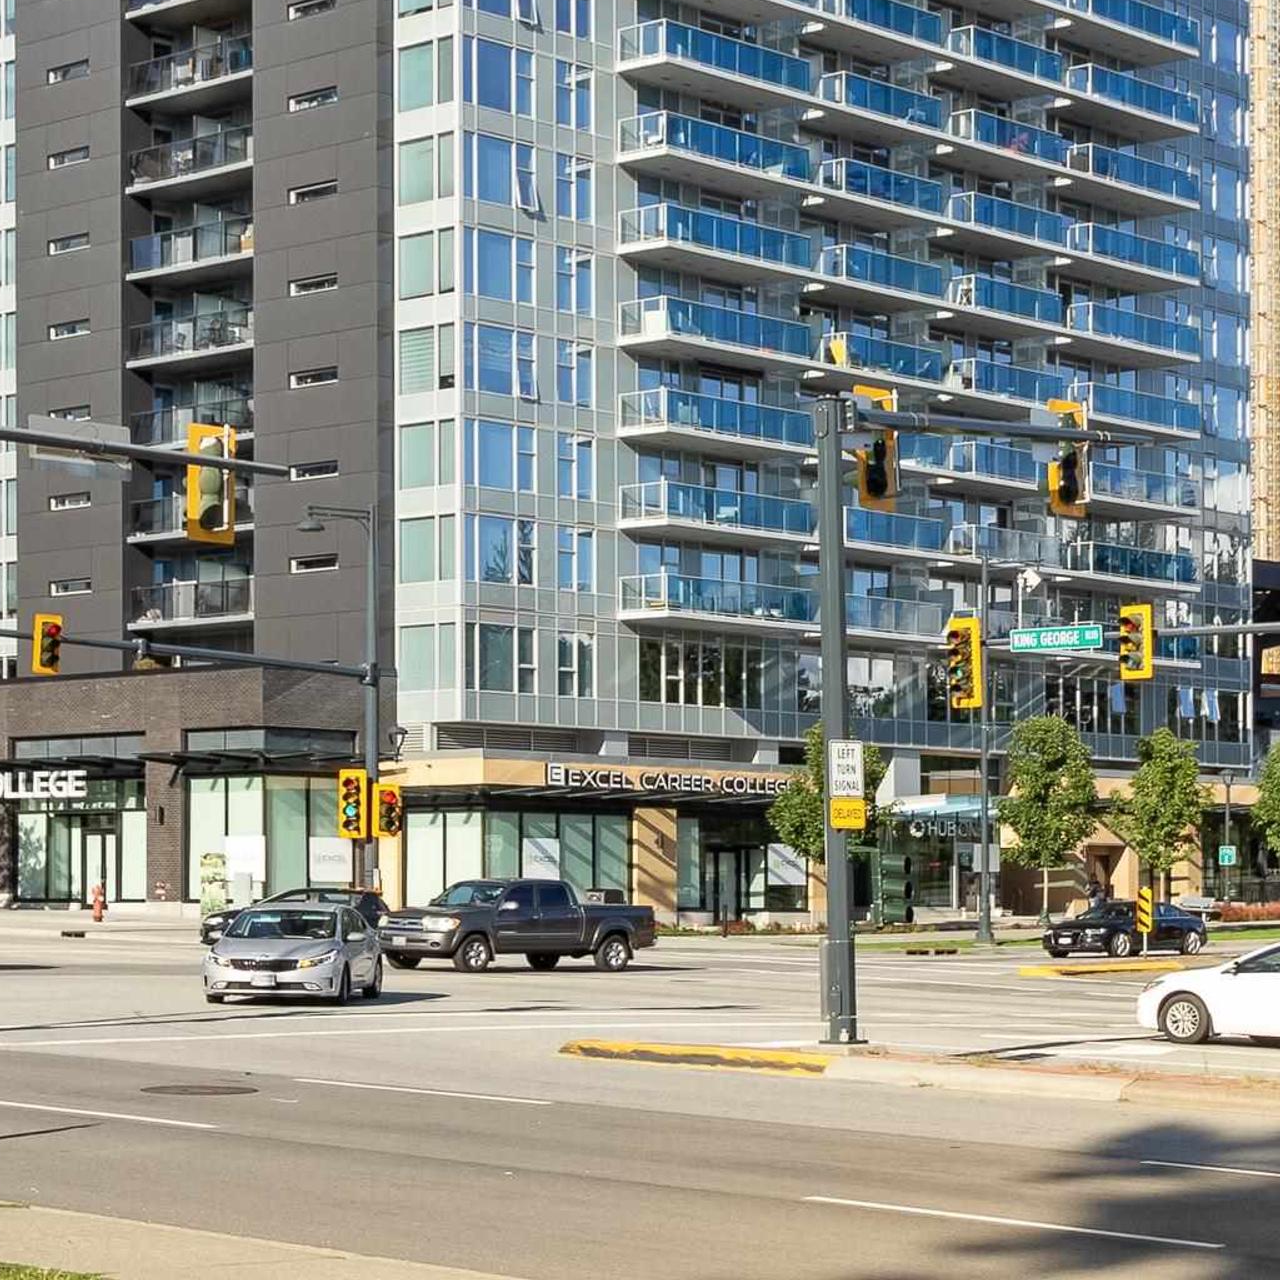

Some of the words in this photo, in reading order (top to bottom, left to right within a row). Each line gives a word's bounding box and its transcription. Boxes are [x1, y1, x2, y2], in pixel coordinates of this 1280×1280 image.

[1013, 632, 1038, 648] KING
[1040, 630, 1080, 647] GEORGE
[837, 748, 856, 759] LEFT
[837, 763, 856, 775] TURN
[568, 770, 635, 789] EXCEL
[640, 772, 714, 792] CAREER
[834, 779, 860, 792] SIGNAL
[927, 820, 957, 837] HUB
